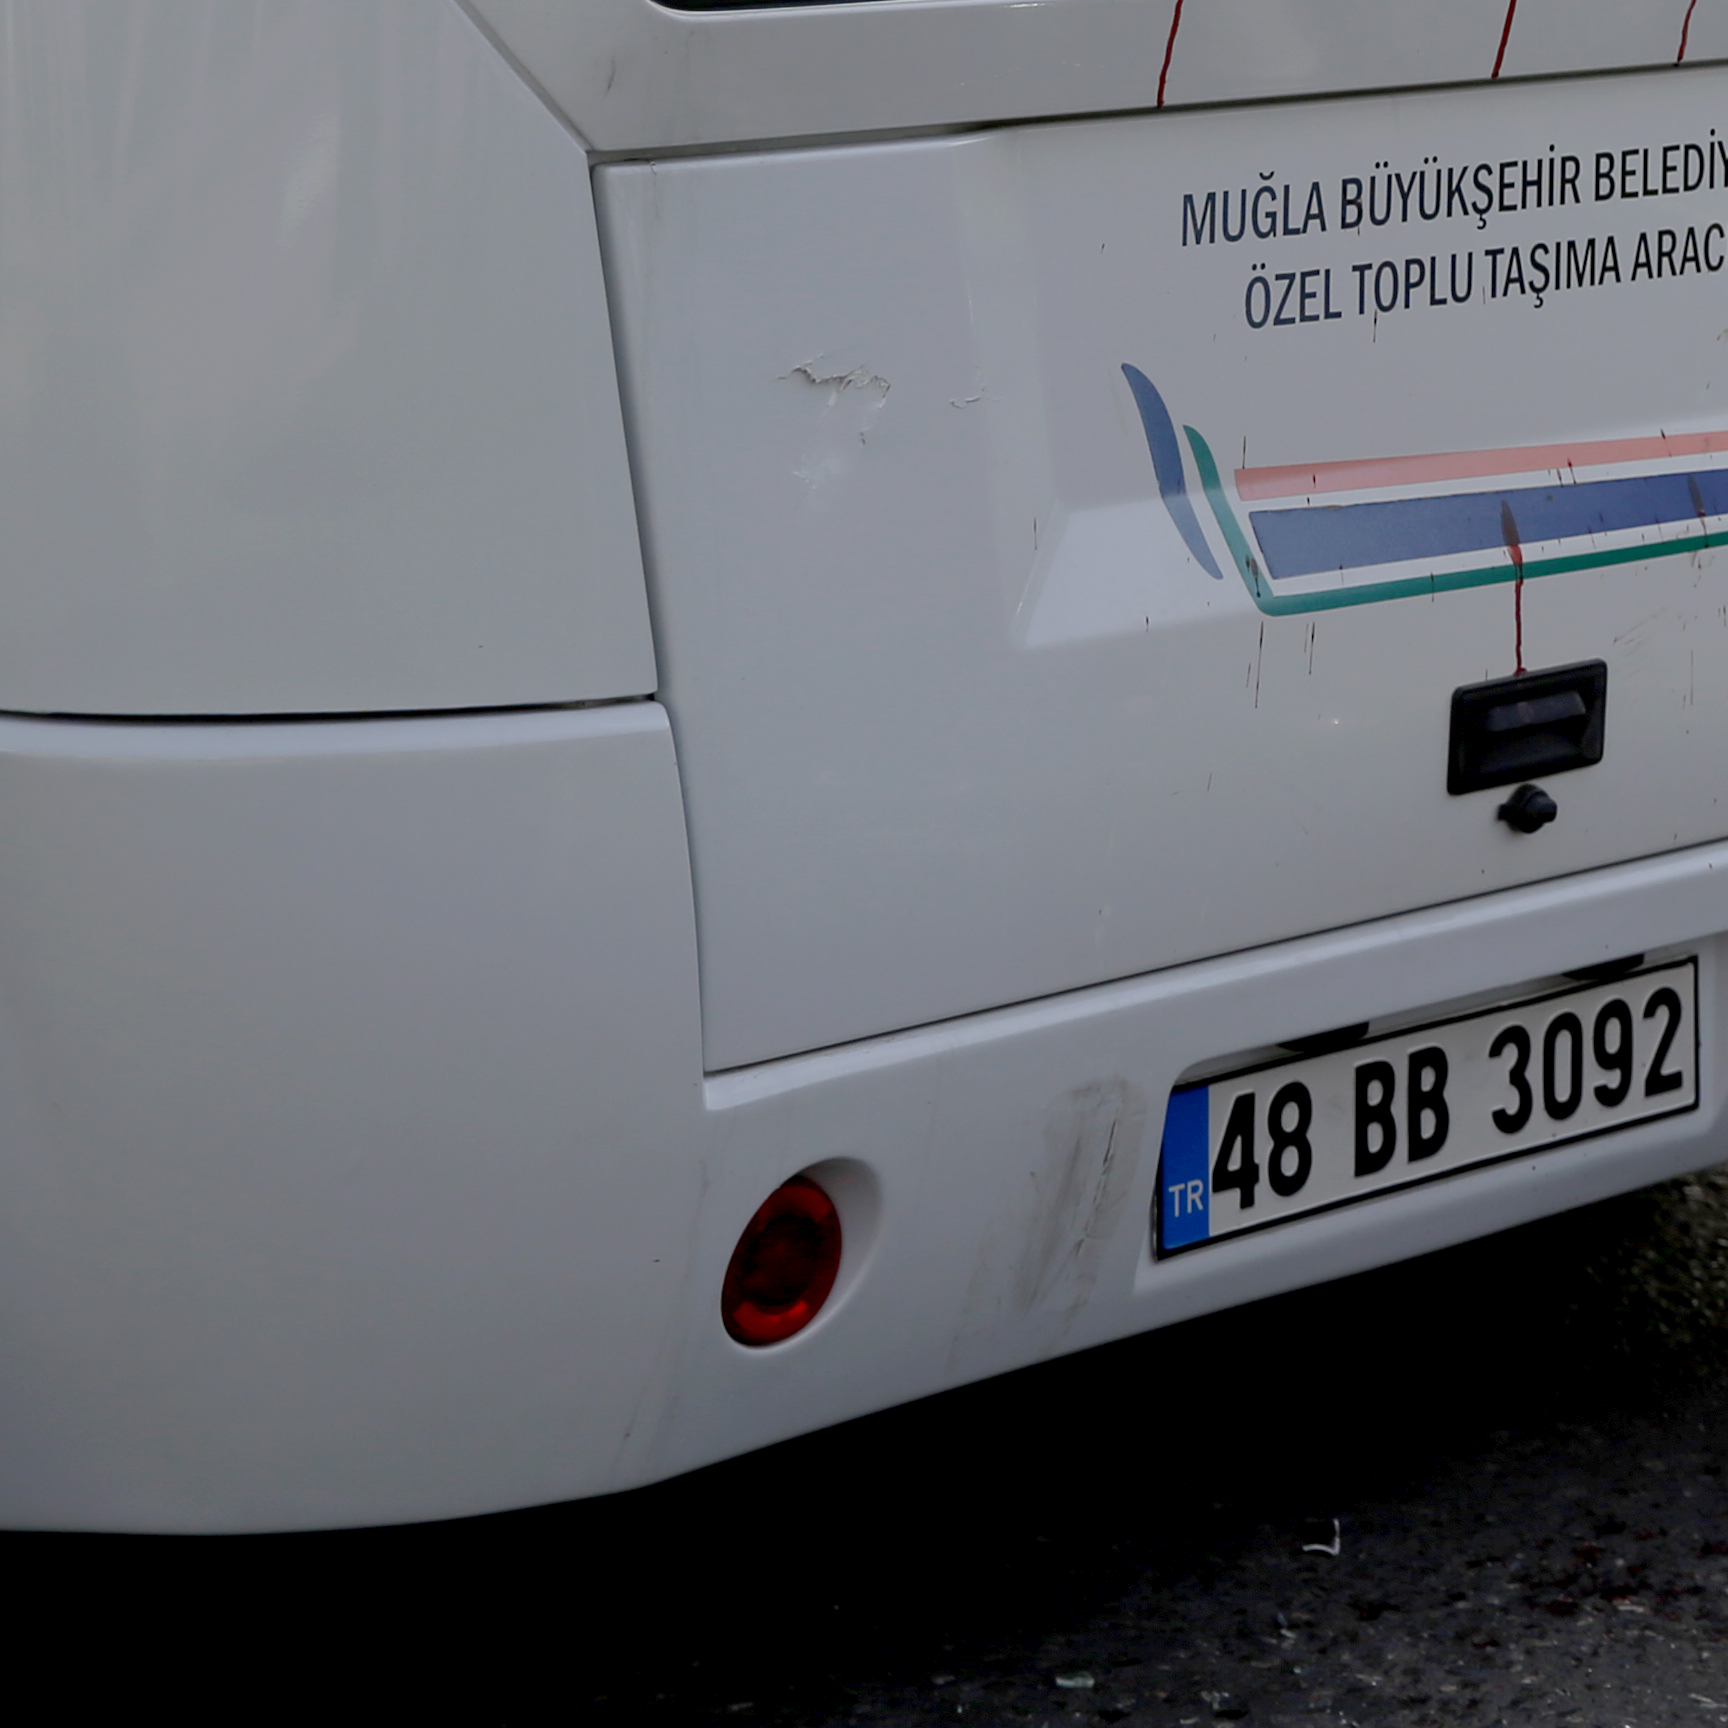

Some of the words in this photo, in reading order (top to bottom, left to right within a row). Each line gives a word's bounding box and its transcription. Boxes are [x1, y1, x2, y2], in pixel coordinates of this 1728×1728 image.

[1181, 171, 1328, 247] MUĞLA
[1340, 144, 1581, 231] BÜYÜKŞEHİR
[1245, 263, 1343, 330] ÖZEL
[1351, 251, 1474, 316] TOPLU
[1485, 235, 1622, 309] TAŞIMA
[1211, 1080, 1313, 1210] 48
[1354, 1045, 1449, 1177] BB
[1487, 986, 1684, 1134] 3092
[1168, 1178, 1205, 1218] TR
